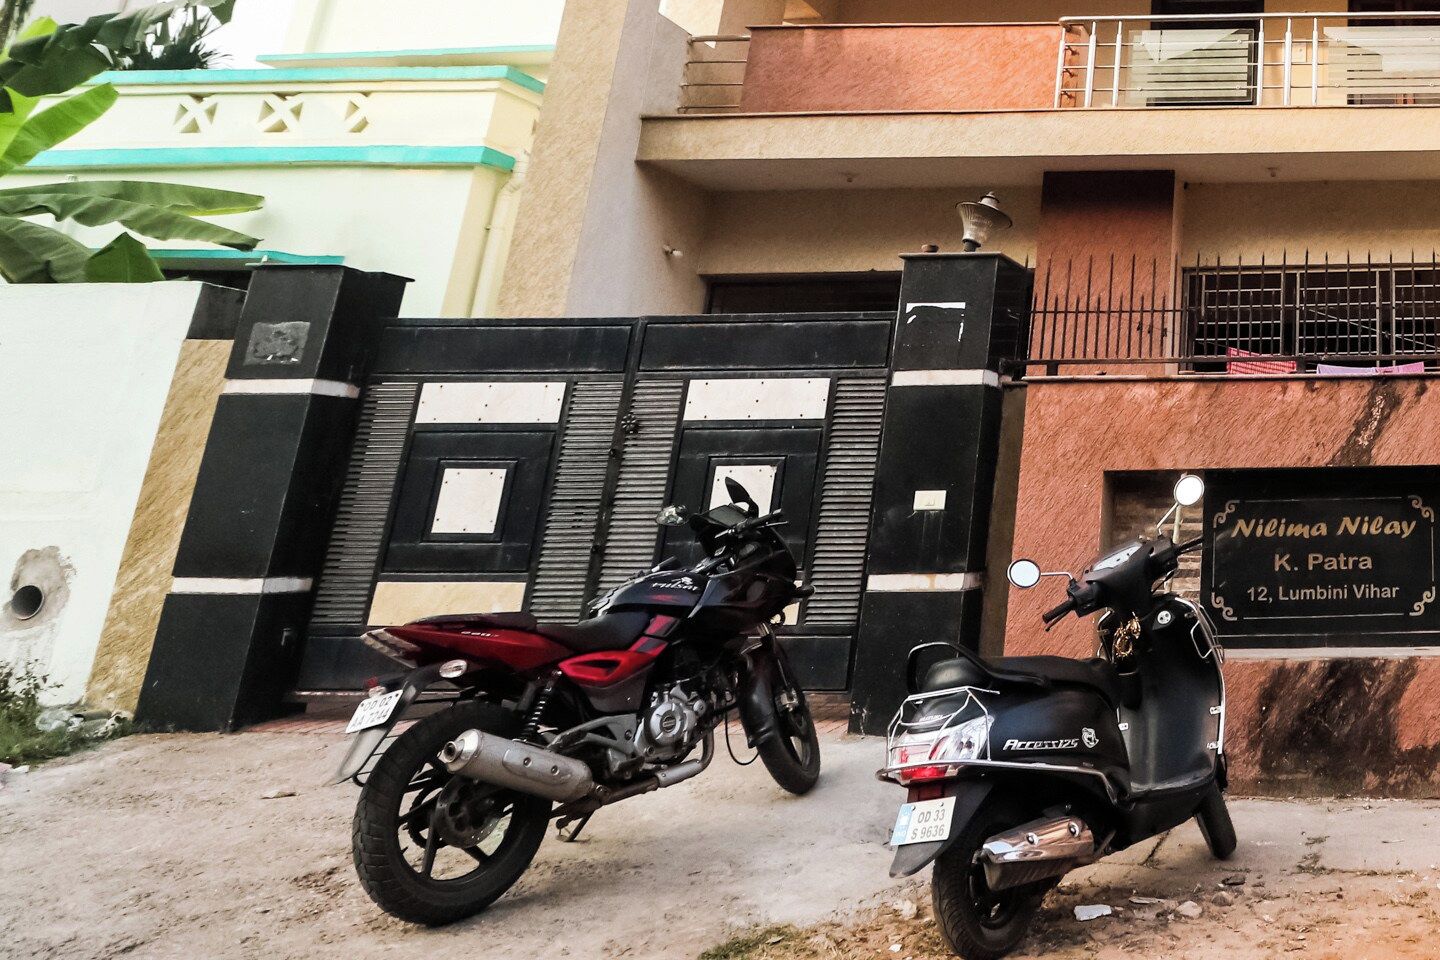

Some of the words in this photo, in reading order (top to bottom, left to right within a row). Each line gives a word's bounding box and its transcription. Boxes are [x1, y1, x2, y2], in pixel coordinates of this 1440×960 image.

[1231, 518, 1327, 538] Nilima
[1336, 516, 1417, 538] Nilay
[1273, 554, 1299, 572] K.
[1307, 553, 1373, 571] Patra
[1247, 587, 1273, 603] 12,
[1278, 585, 1348, 601] Lumbini
[1353, 584, 1400, 599] Vihar
[917, 811, 931, 823] OD
[934, 809, 945, 822] 33
[911, 828, 918, 840] S
[920, 824, 945, 839] 9636
